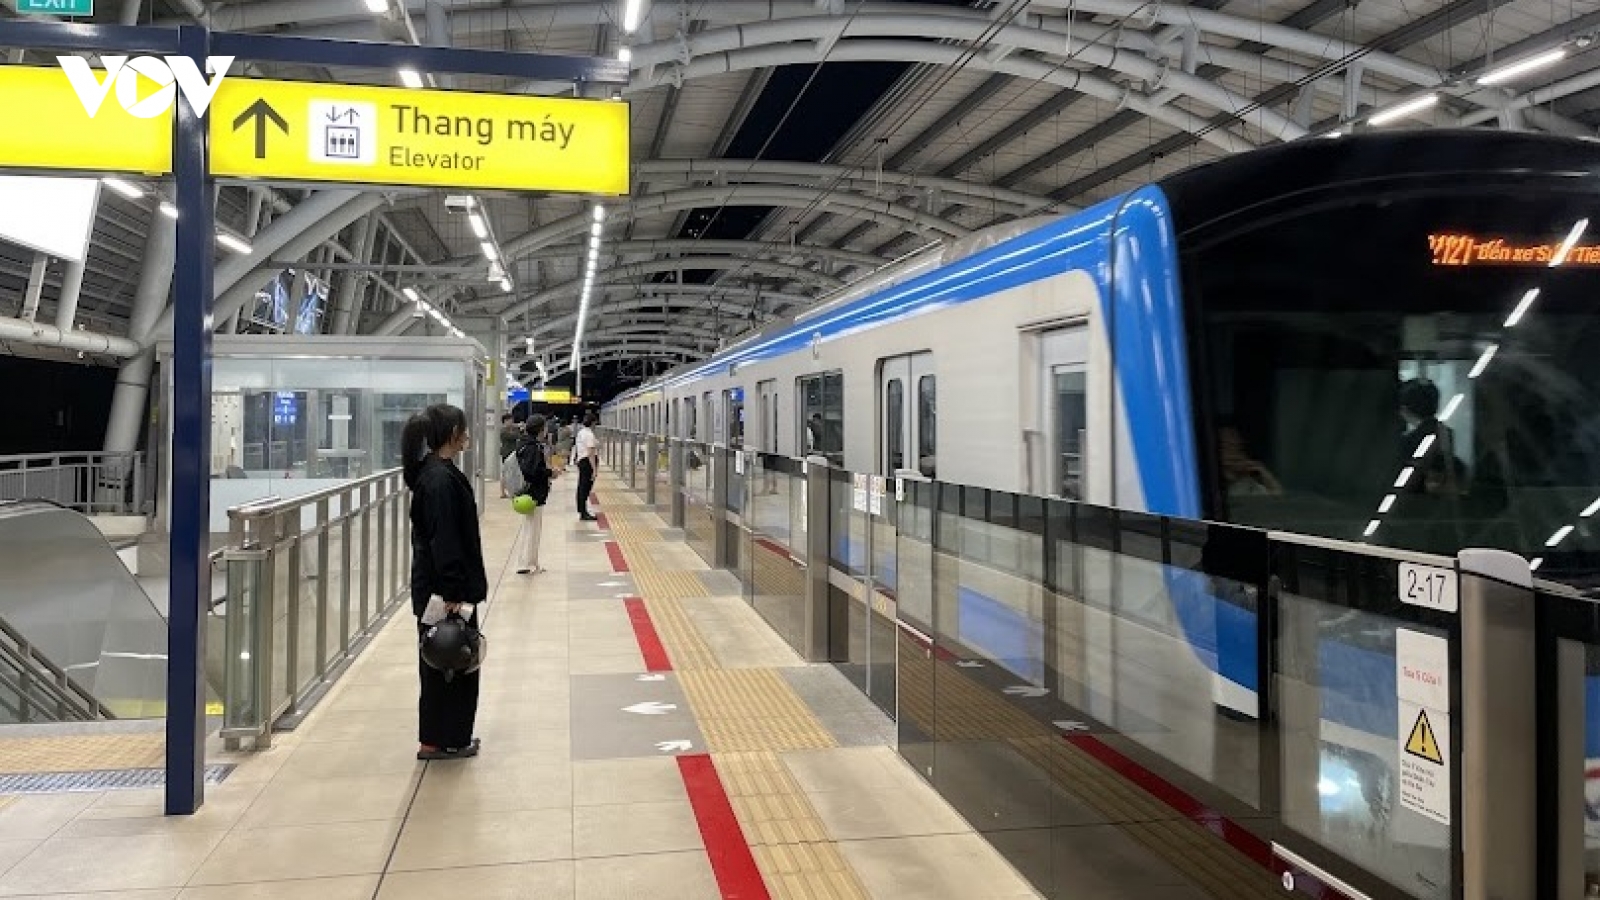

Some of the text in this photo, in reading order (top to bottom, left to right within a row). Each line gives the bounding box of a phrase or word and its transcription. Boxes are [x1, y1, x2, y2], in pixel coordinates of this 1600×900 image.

[390, 104, 575, 150] Thang máy
[389, 145, 485, 171] Elevator
[1407, 568, 1447, 604] 2-17
